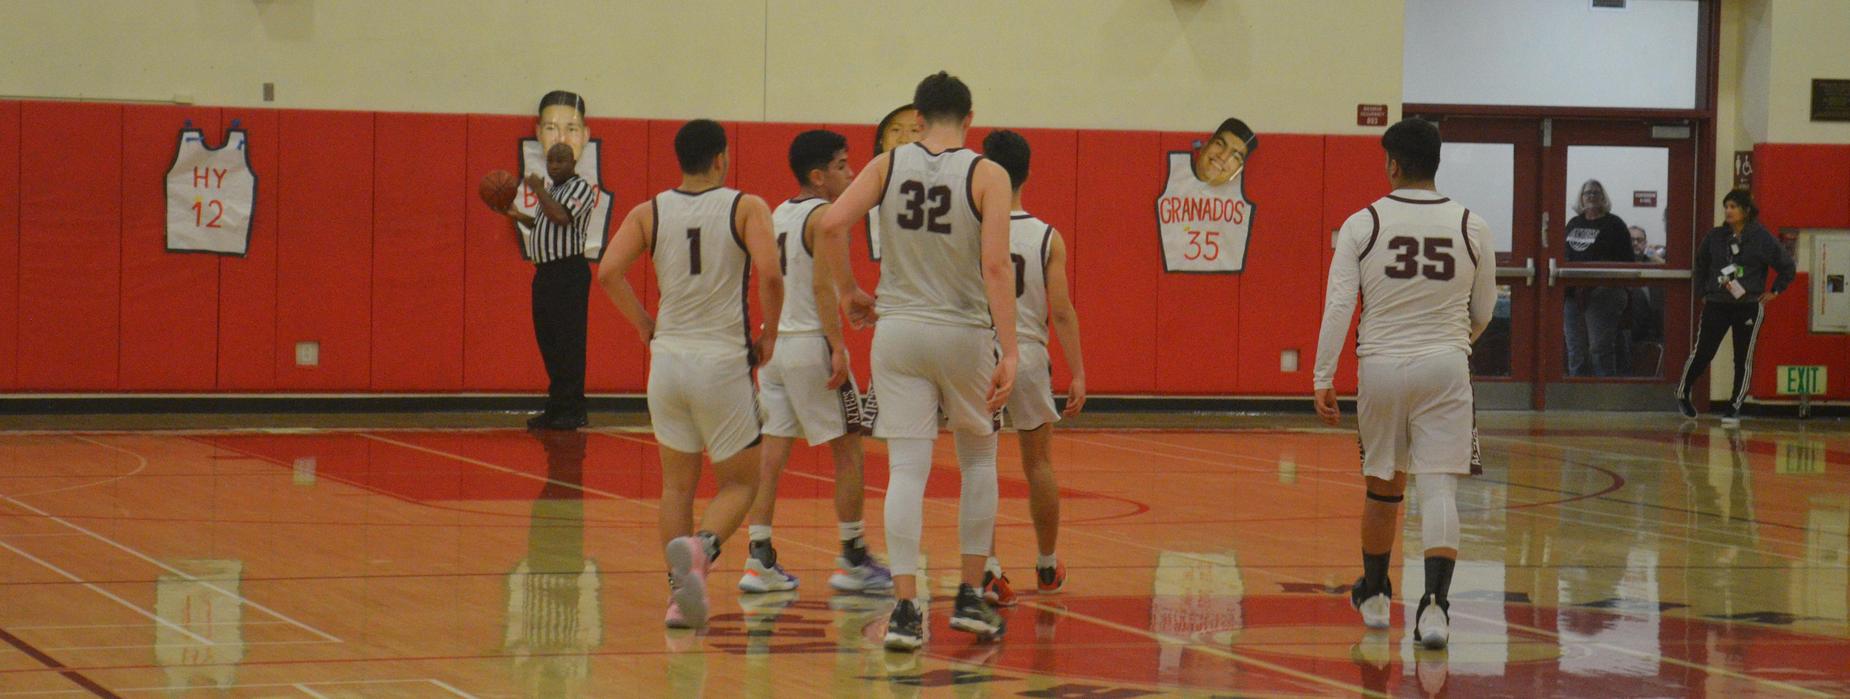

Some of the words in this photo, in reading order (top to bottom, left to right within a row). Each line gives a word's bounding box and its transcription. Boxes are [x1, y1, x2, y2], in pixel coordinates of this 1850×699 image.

[193, 166, 228, 189] HY
[191, 199, 223, 228] 12
[896, 179, 952, 234] 32
[1160, 195, 1245, 224] GRANADOS
[686, 228, 702, 275] 1
[1183, 231, 1220, 261] 35
[1384, 236, 1456, 281] 35
[1786, 366, 1820, 392] EXIT
